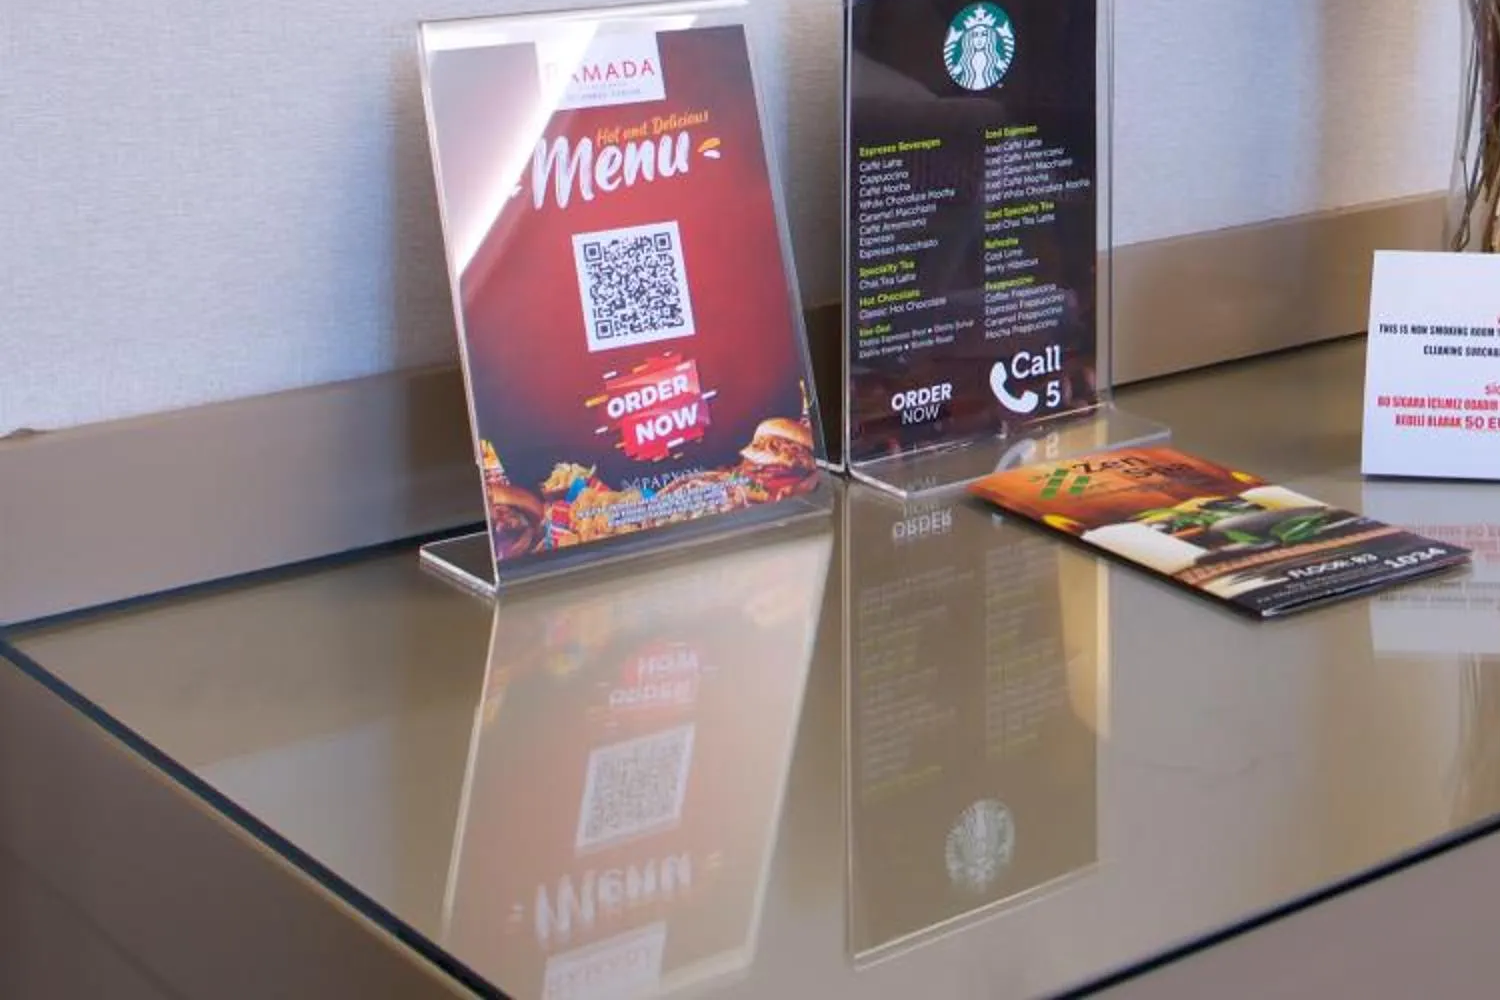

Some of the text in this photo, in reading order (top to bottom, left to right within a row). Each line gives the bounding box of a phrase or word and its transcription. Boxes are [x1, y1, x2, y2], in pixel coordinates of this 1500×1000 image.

[532, 131, 689, 210] Menu
[1011, 345, 1062, 379] Call
[607, 374, 689, 418] ORDER
[891, 382, 953, 411] ORDER
[1046, 380, 1061, 407] 5
[635, 403, 699, 445] NOW
[901, 404, 940, 425] NOW
[1465, 415, 1485, 429] 50
